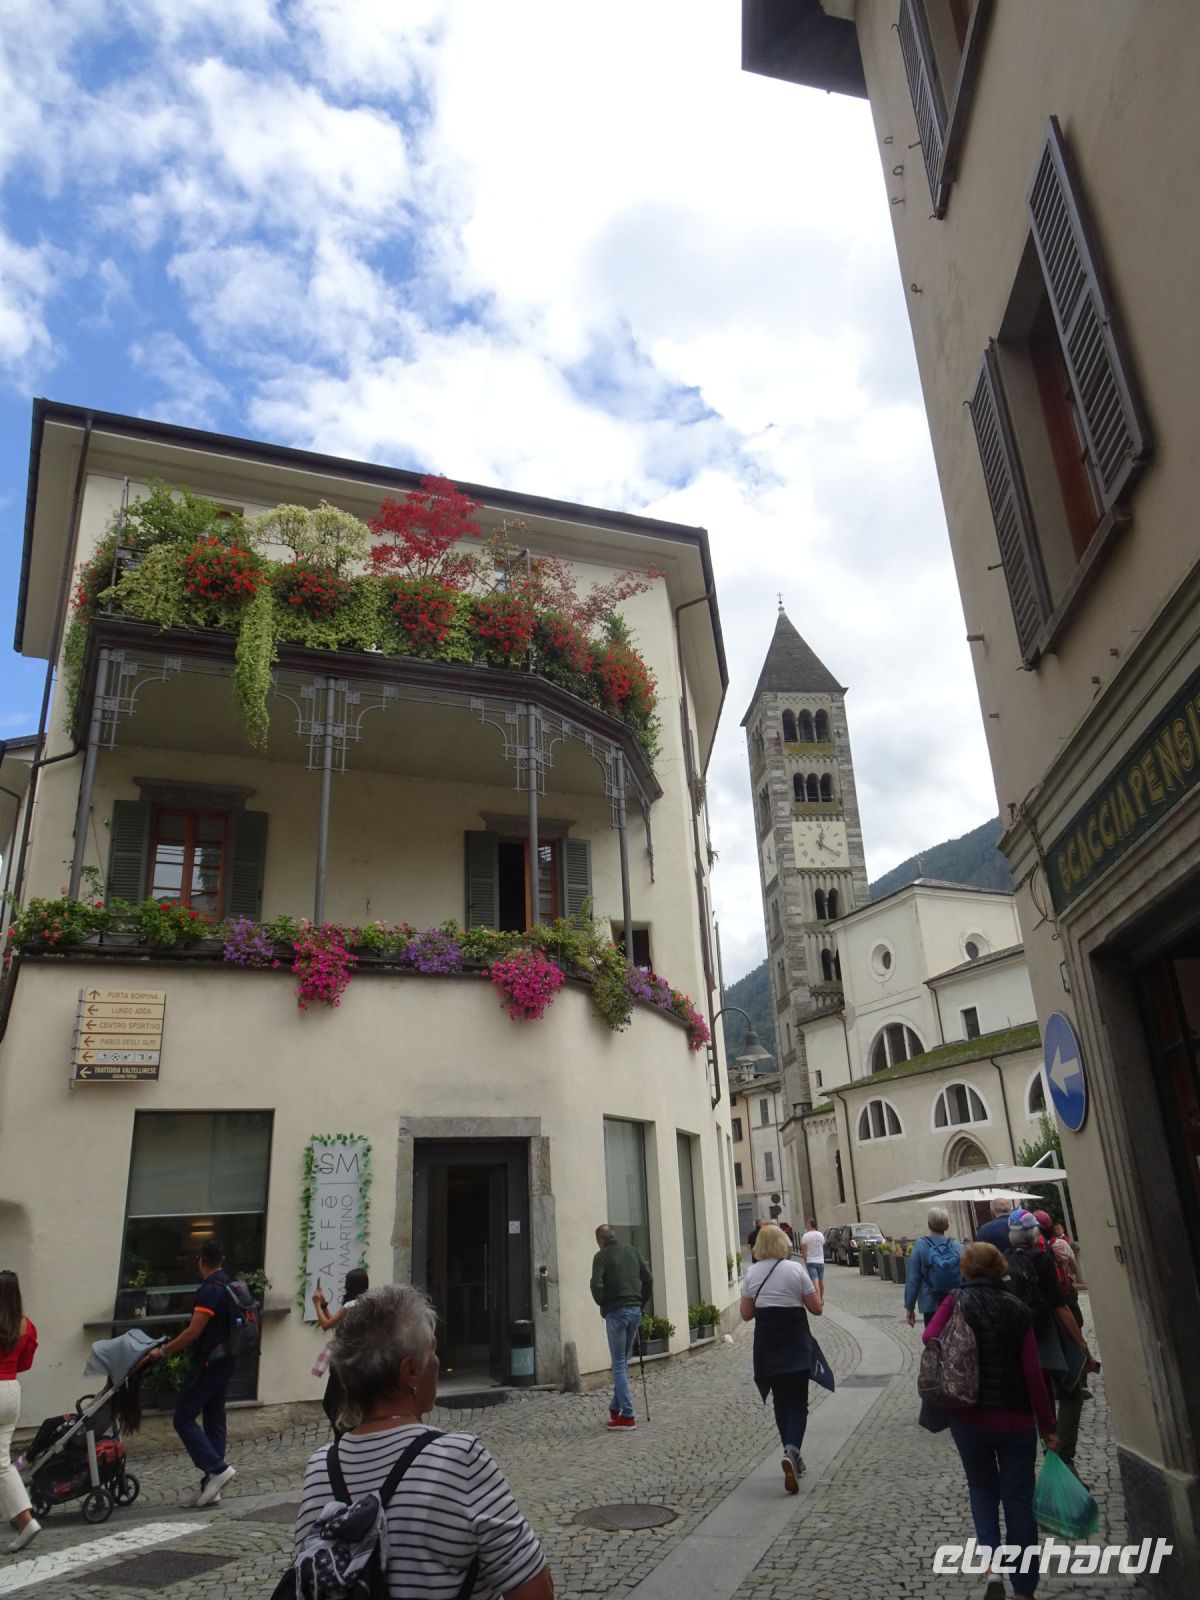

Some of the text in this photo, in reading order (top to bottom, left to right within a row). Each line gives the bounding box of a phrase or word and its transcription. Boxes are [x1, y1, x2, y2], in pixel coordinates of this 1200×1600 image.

[108, 992, 129, 1000] PORTA
[99, 1021, 161, 1030] CENTRO SPORTIVO
[122, 1038, 141, 1046] DEGLI
[320, 1152, 360, 1175] SM
[339, 1194, 353, 1266] MARTINO
